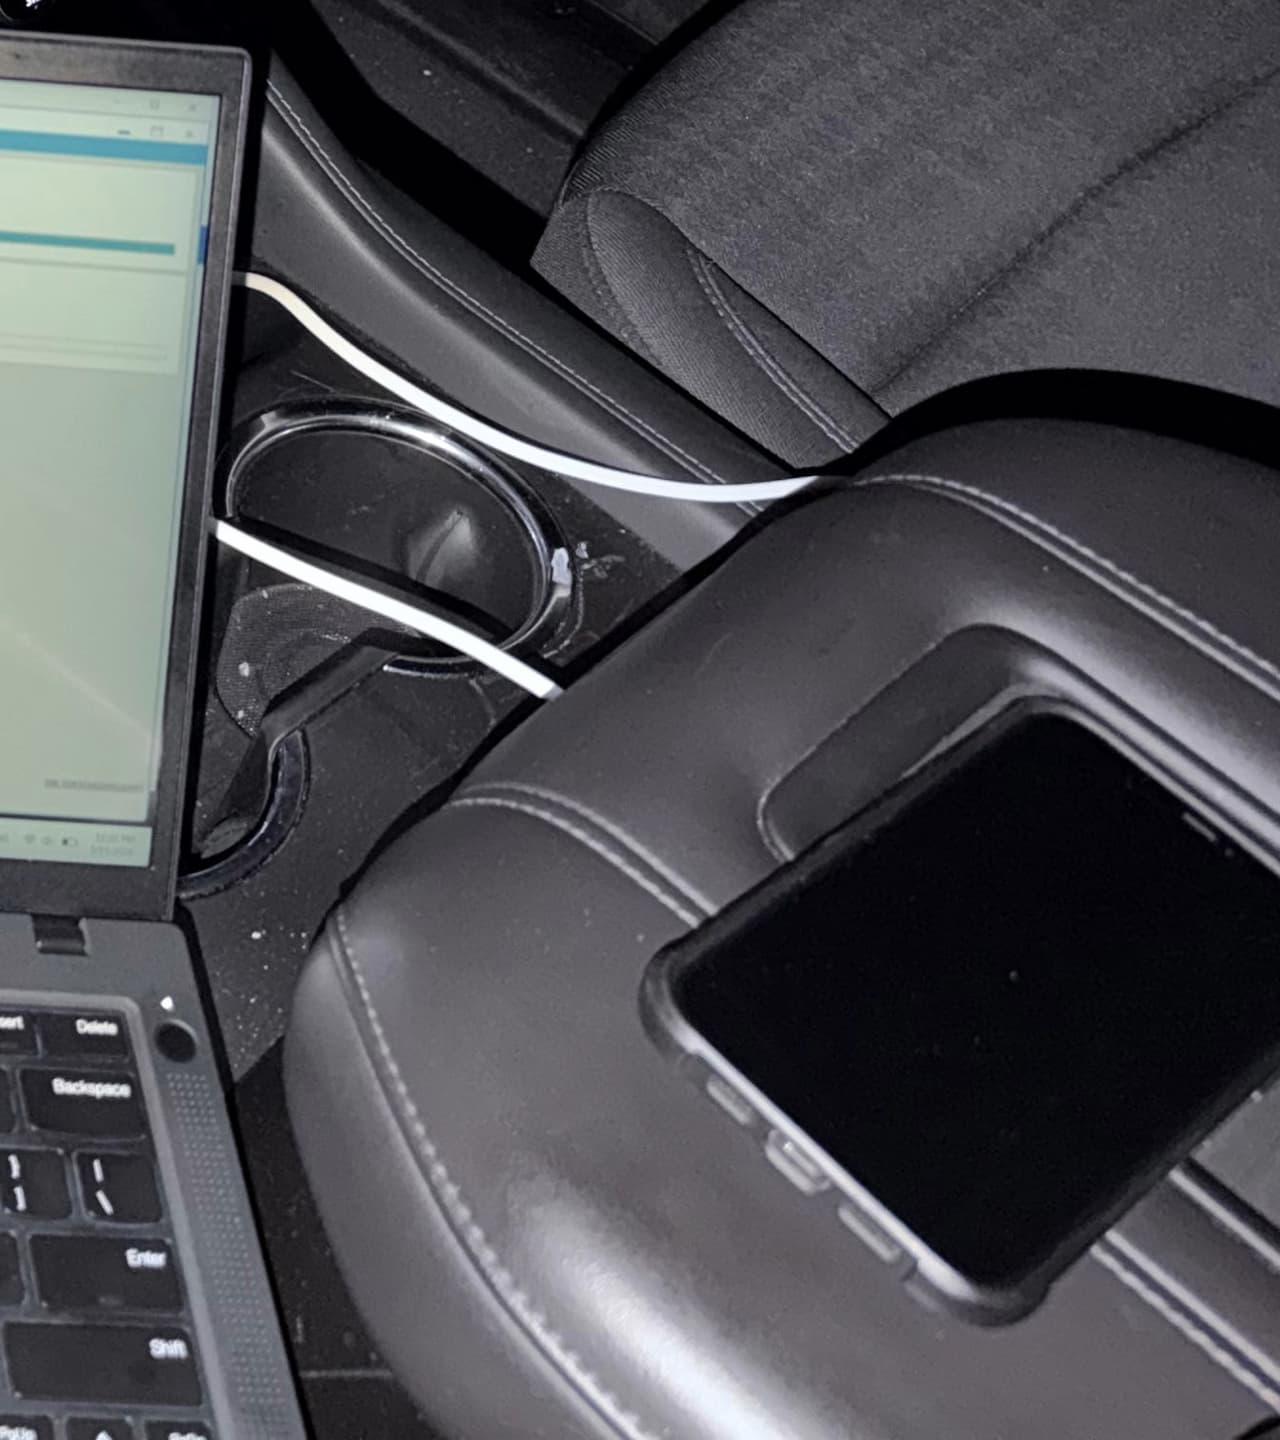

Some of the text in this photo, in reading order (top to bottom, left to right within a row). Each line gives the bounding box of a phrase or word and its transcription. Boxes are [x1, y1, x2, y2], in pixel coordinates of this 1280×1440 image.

[75, 1018, 118, 1036] Delete
[52, 1077, 131, 1099] Backspace
[125, 1248, 166, 1268] Enter
[149, 1338, 188, 1359] Shift
